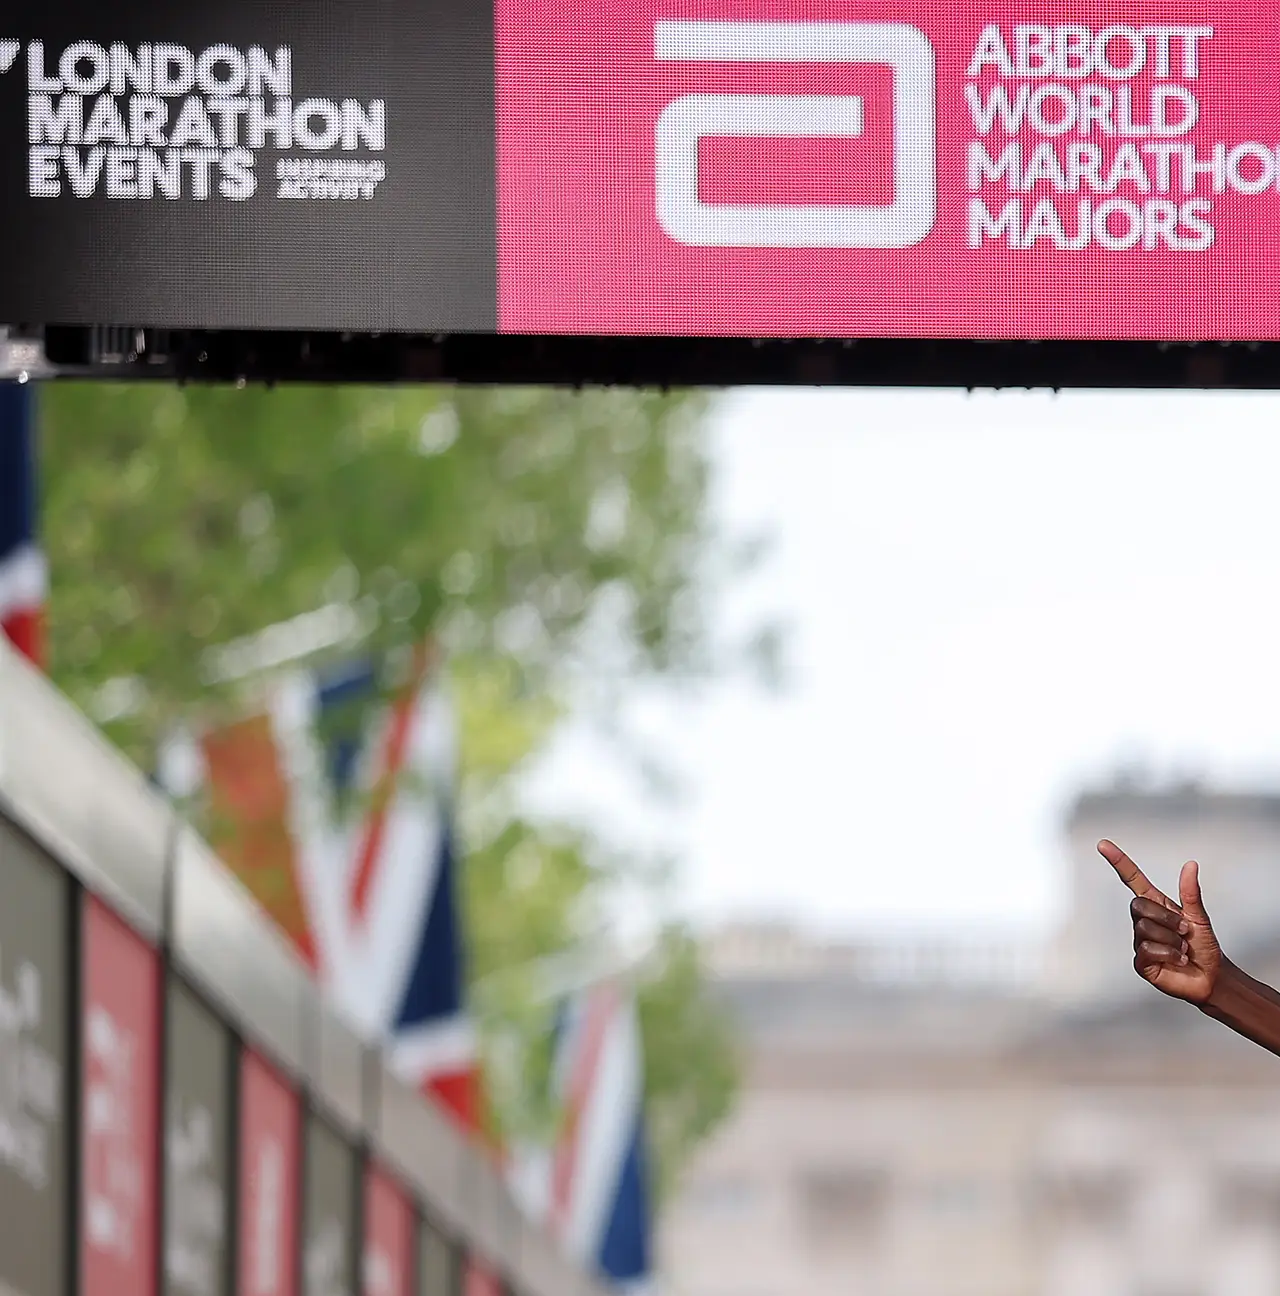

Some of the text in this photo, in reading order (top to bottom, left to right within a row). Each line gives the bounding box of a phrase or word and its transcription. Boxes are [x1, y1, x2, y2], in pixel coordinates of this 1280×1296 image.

[27, 39, 292, 96] LONDON
[965, 24, 1214, 80] ABBOTT
[28, 93, 386, 151] MARATHON
[965, 84, 1199, 137] WORLD
[28, 146, 259, 200] EVENTS
[966, 198, 1214, 252] MAJORS
